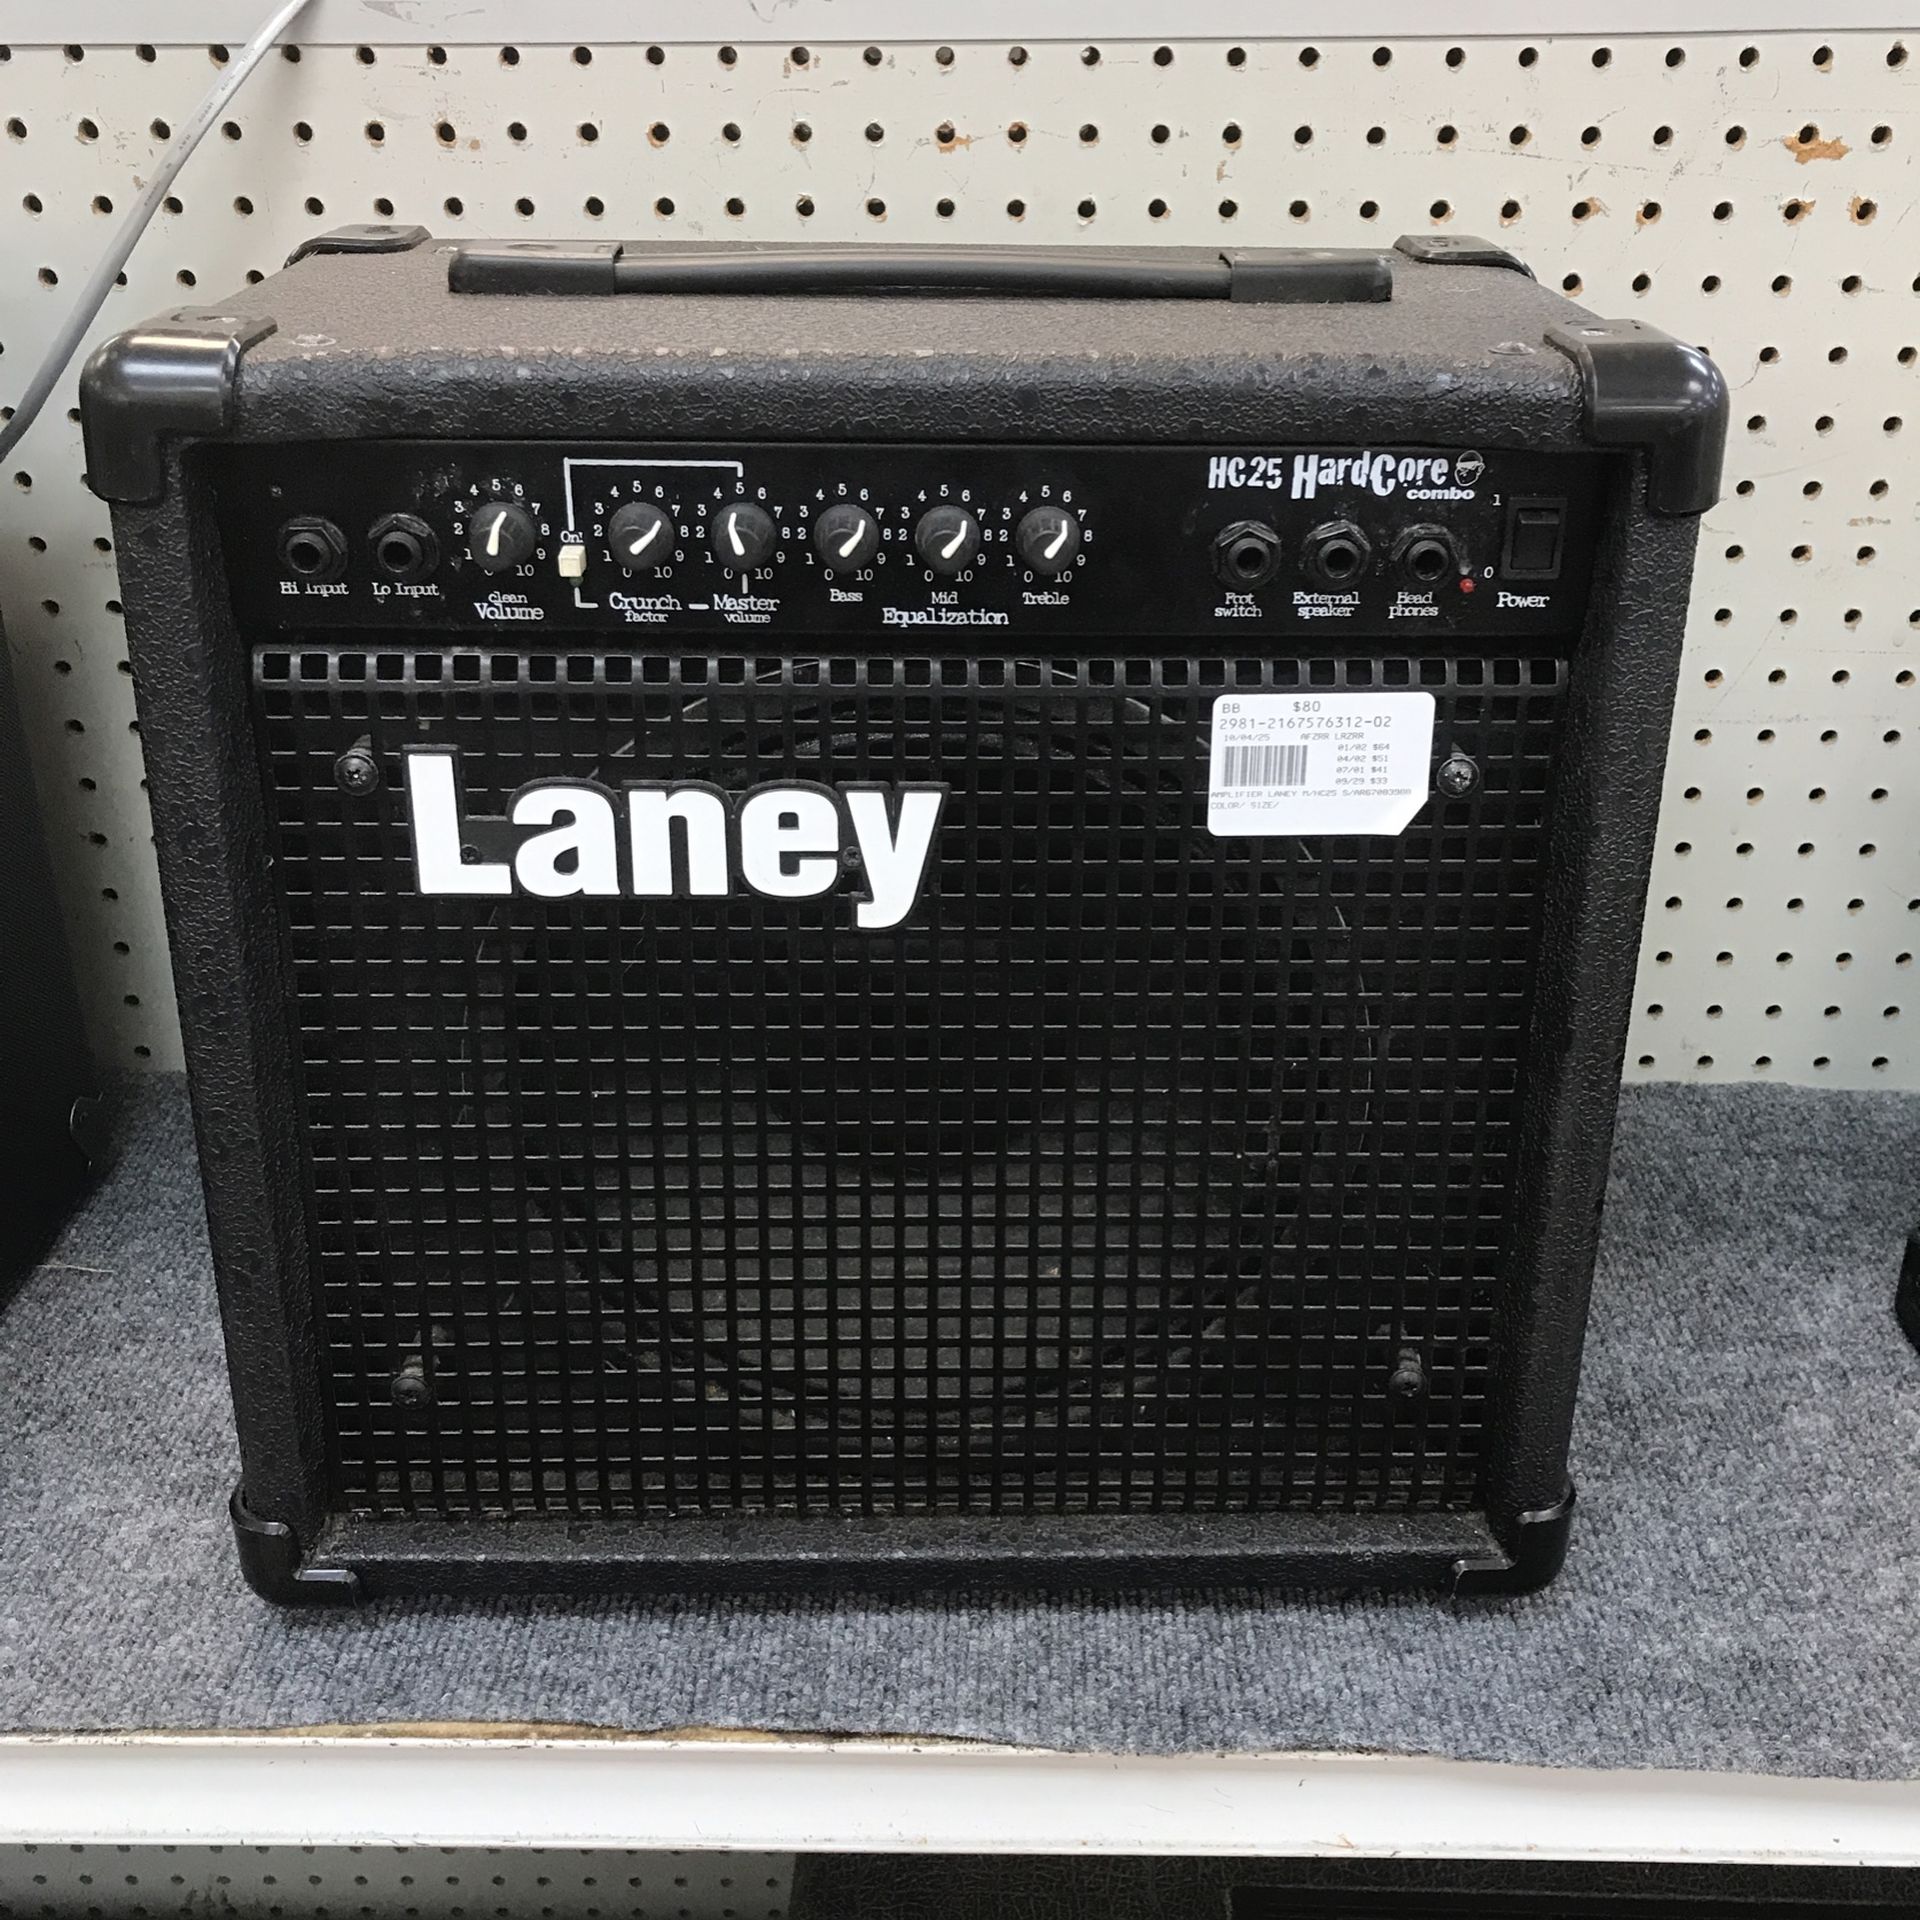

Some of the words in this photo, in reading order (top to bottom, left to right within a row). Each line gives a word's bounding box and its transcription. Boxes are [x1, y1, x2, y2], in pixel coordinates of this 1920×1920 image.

[1207, 456, 1283, 490] HC25
[1290, 450, 1449, 500] HardCore
[469, 484, 480, 496] 4
[491, 478, 502, 492] 5
[514, 483, 524, 497] 6
[610, 485, 620, 498] 4
[632, 480, 642, 493] 5
[735, 481, 745, 495] 5
[837, 483, 847, 496] 5
[939, 484, 949, 497] 5
[1040, 484, 1051, 498] 5
[654, 485, 664, 499] 6
[713, 486, 723, 500] 4
[757, 486, 767, 500] 6
[815, 488, 825, 501] 4
[859, 488, 869, 501] 6
[917, 489, 927, 502] 4
[961, 489, 971, 502] 6
[1019, 490, 1029, 503] 4
[1062, 490, 1072, 503] 6
[1406, 485, 1476, 500] combo
[454, 500, 467, 513] 3
[531, 502, 541, 516] 7
[594, 502, 605, 515] 3
[671, 504, 681, 517] 7
[697, 503, 707, 517] 3
[773, 505, 783, 519] 7
[799, 505, 809, 518] 3
[901, 506, 911, 519] 3
[875, 507, 885, 520] 7
[976, 508, 986, 521] 7
[1002, 507, 1012, 520] 3
[1077, 508, 1087, 522] 7
[453, 522, 464, 535] 2
[540, 523, 550, 536] 8
[593, 523, 603, 537] 2
[680, 525, 689, 538] 8
[695, 525, 705, 539] 2
[781, 526, 791, 539] 8
[797, 526, 807, 540] 2
[883, 527, 892, 541] 8
[898, 528, 908, 541] 2
[983, 528, 993, 542] 8
[999, 528, 1008, 542] 2
[1083, 529, 1093, 542] 8
[463, 548, 473, 560] 1
[536, 547, 546, 560] 9
[602, 549, 613, 562] 1
[674, 549, 685, 562] 9
[704, 551, 714, 564] 1
[776, 551, 786, 564] 9
[805, 552, 814, 565] 1
[877, 552, 886, 565] 9
[906, 554, 915, 566] 1
[977, 553, 986, 566] 9
[1076, 554, 1086, 566] 9
[1006, 554, 1015, 567] 1
[516, 564, 534, 577] 10
[654, 566, 673, 579] 10
[723, 567, 733, 580] 0
[755, 567, 774, 580] 10
[824, 568, 834, 581] 0
[855, 568, 874, 581] 10
[924, 569, 934, 582] 0
[955, 569, 973, 582] 10
[1023, 570, 1034, 583] 0
[1054, 570, 1073, 583] 10
[279, 581, 301, 595] Hi
[305, 581, 349, 598] input
[371, 582, 391, 596] Lo
[394, 582, 440, 599] Input
[829, 588, 863, 603] Bass
[608, 591, 683, 611] Crunch
[712, 593, 781, 612] Master
[931, 591, 959, 605] Mid
[1022, 591, 1070, 606] Treble
[1225, 591, 1255, 605] Foot
[1292, 591, 1361, 605] External
[1396, 591, 1433, 605] Head
[1496, 591, 1550, 608] Power
[473, 602, 545, 621] Volume
[624, 609, 669, 623] factor
[723, 610, 771, 624] volume
[882, 607, 1010, 627] Equalization
[1214, 604, 1262, 617] switch
[1297, 604, 1355, 620] speaker
[1388, 604, 1439, 619] phones
[1222, 703, 1241, 714] BB
[1293, 701, 1321, 713] $80
[1219, 716, 1392, 730] 2981-2167576312-02
[408, 754, 942, 929] Laney
